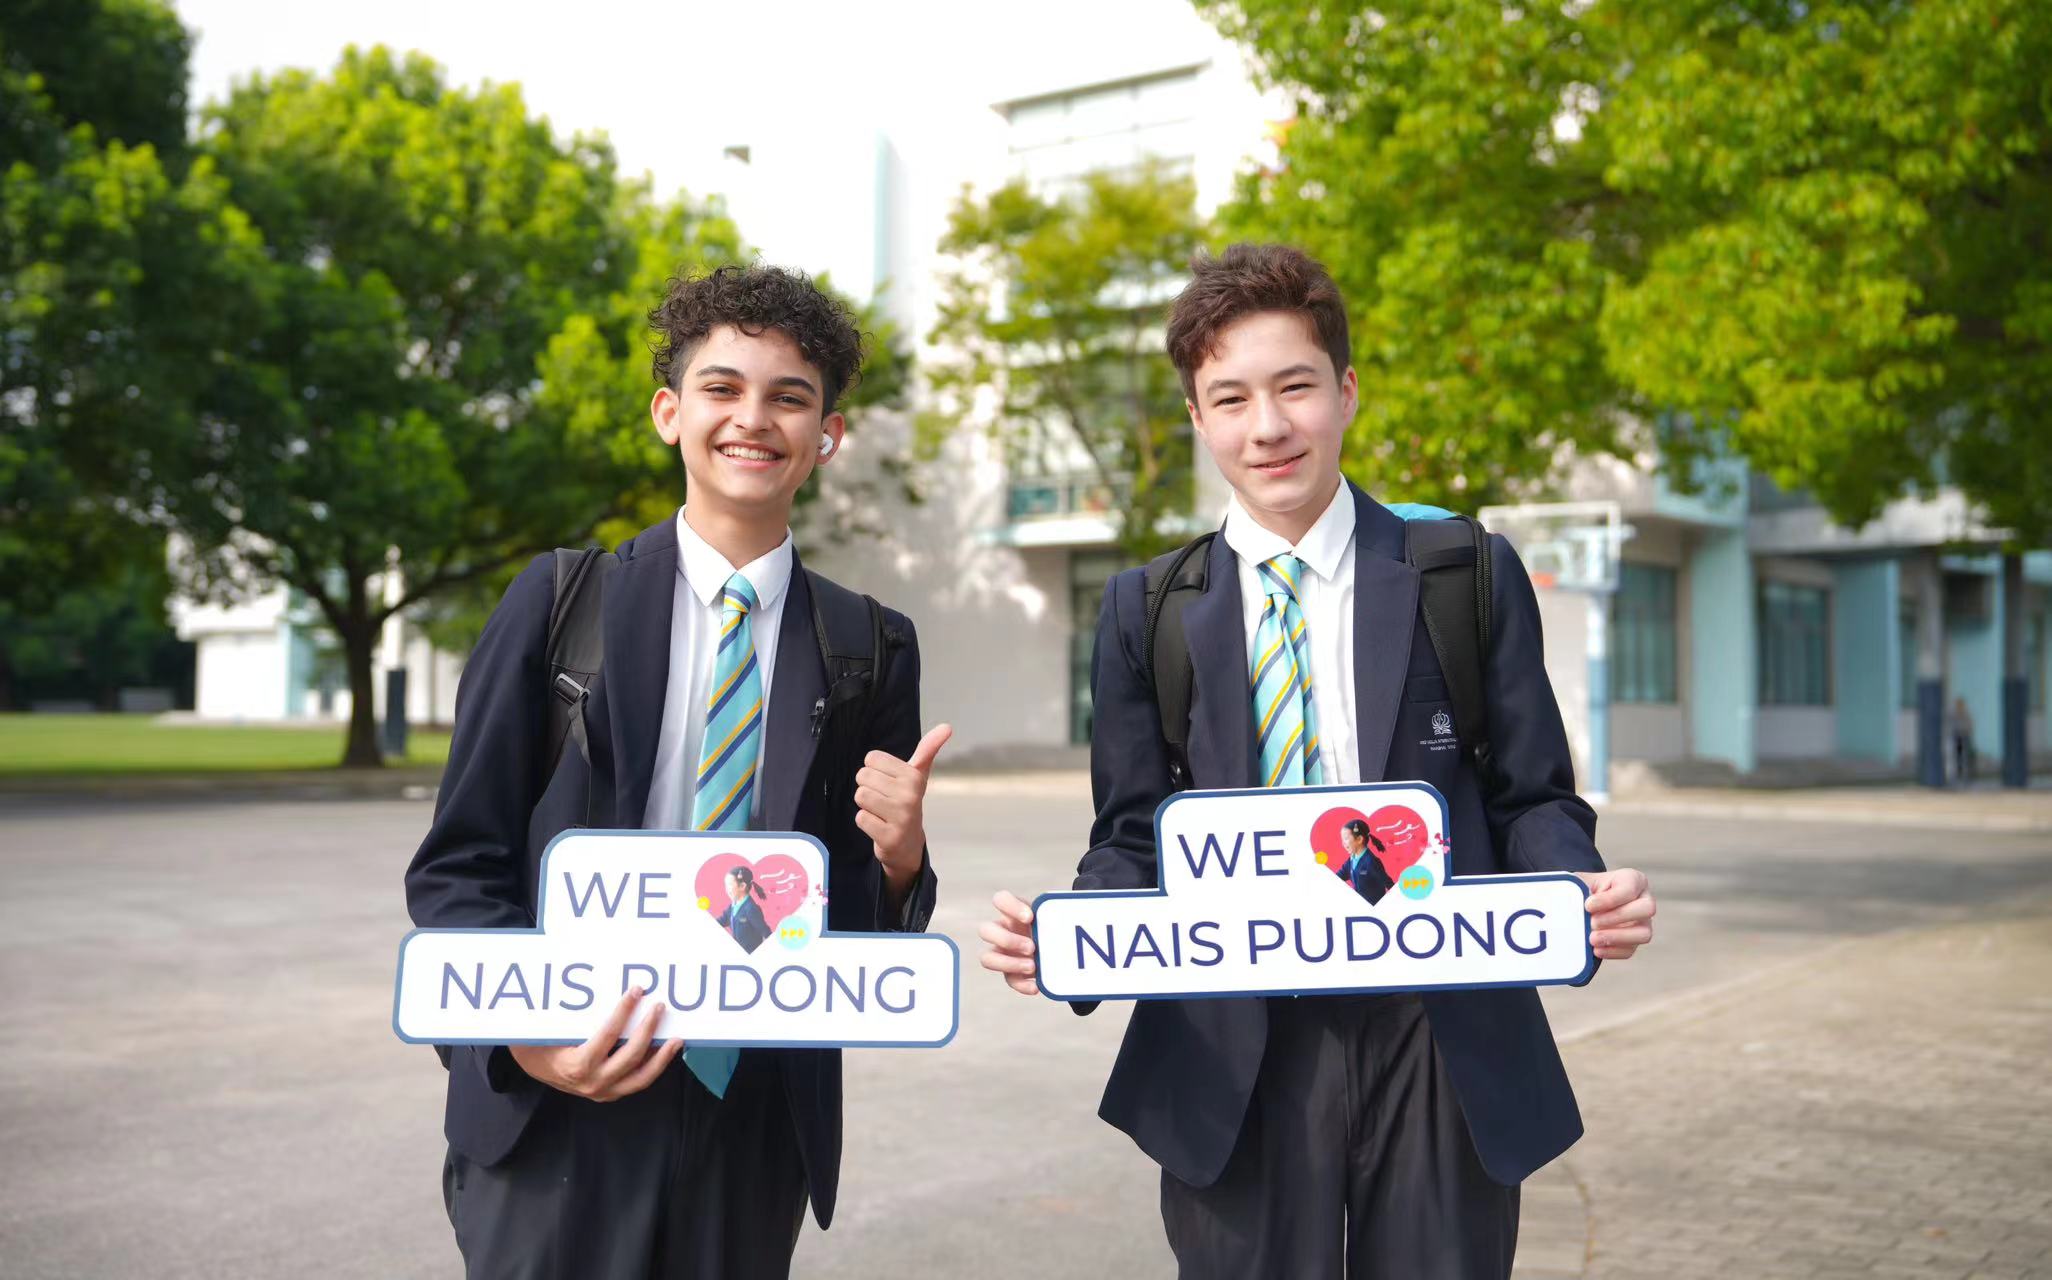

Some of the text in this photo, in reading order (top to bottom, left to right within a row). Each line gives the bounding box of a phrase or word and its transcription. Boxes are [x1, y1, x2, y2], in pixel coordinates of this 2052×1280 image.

[1177, 829, 1290, 880] WE
[563, 871, 672, 919] WE
[1074, 908, 1548, 970] NAIS PUDONG
[440, 962, 916, 1014] NAIS PUDONG
